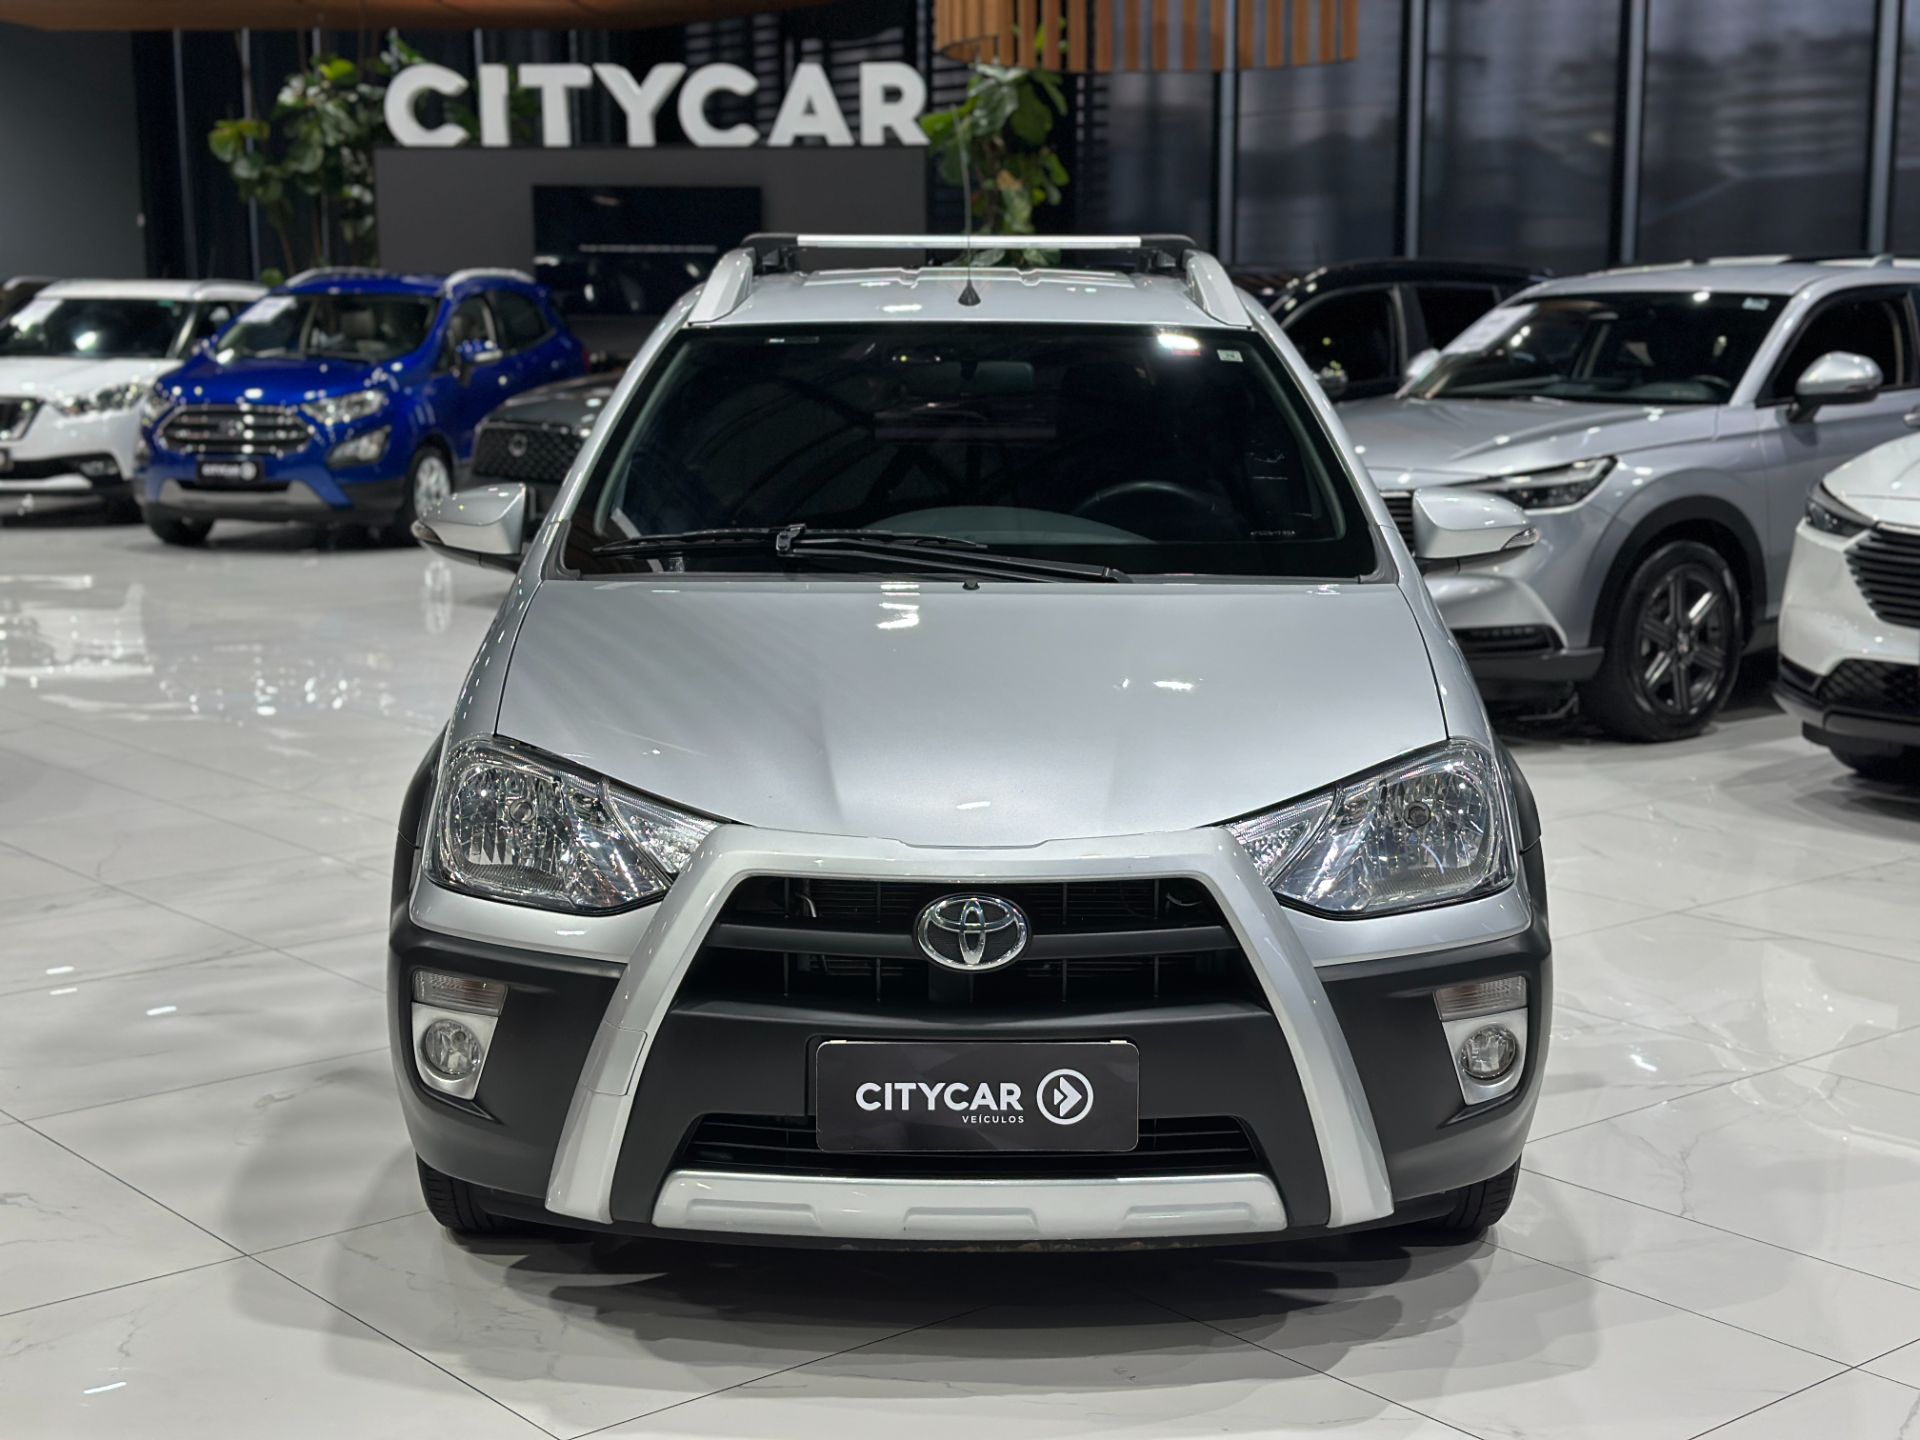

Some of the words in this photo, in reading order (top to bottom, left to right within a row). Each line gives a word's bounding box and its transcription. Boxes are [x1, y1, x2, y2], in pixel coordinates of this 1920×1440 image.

[384, 63, 929, 148] CITYCAR
[855, 1082, 1024, 1111] CITYCAR
[962, 1114, 1024, 1124] VEÍCULOS
